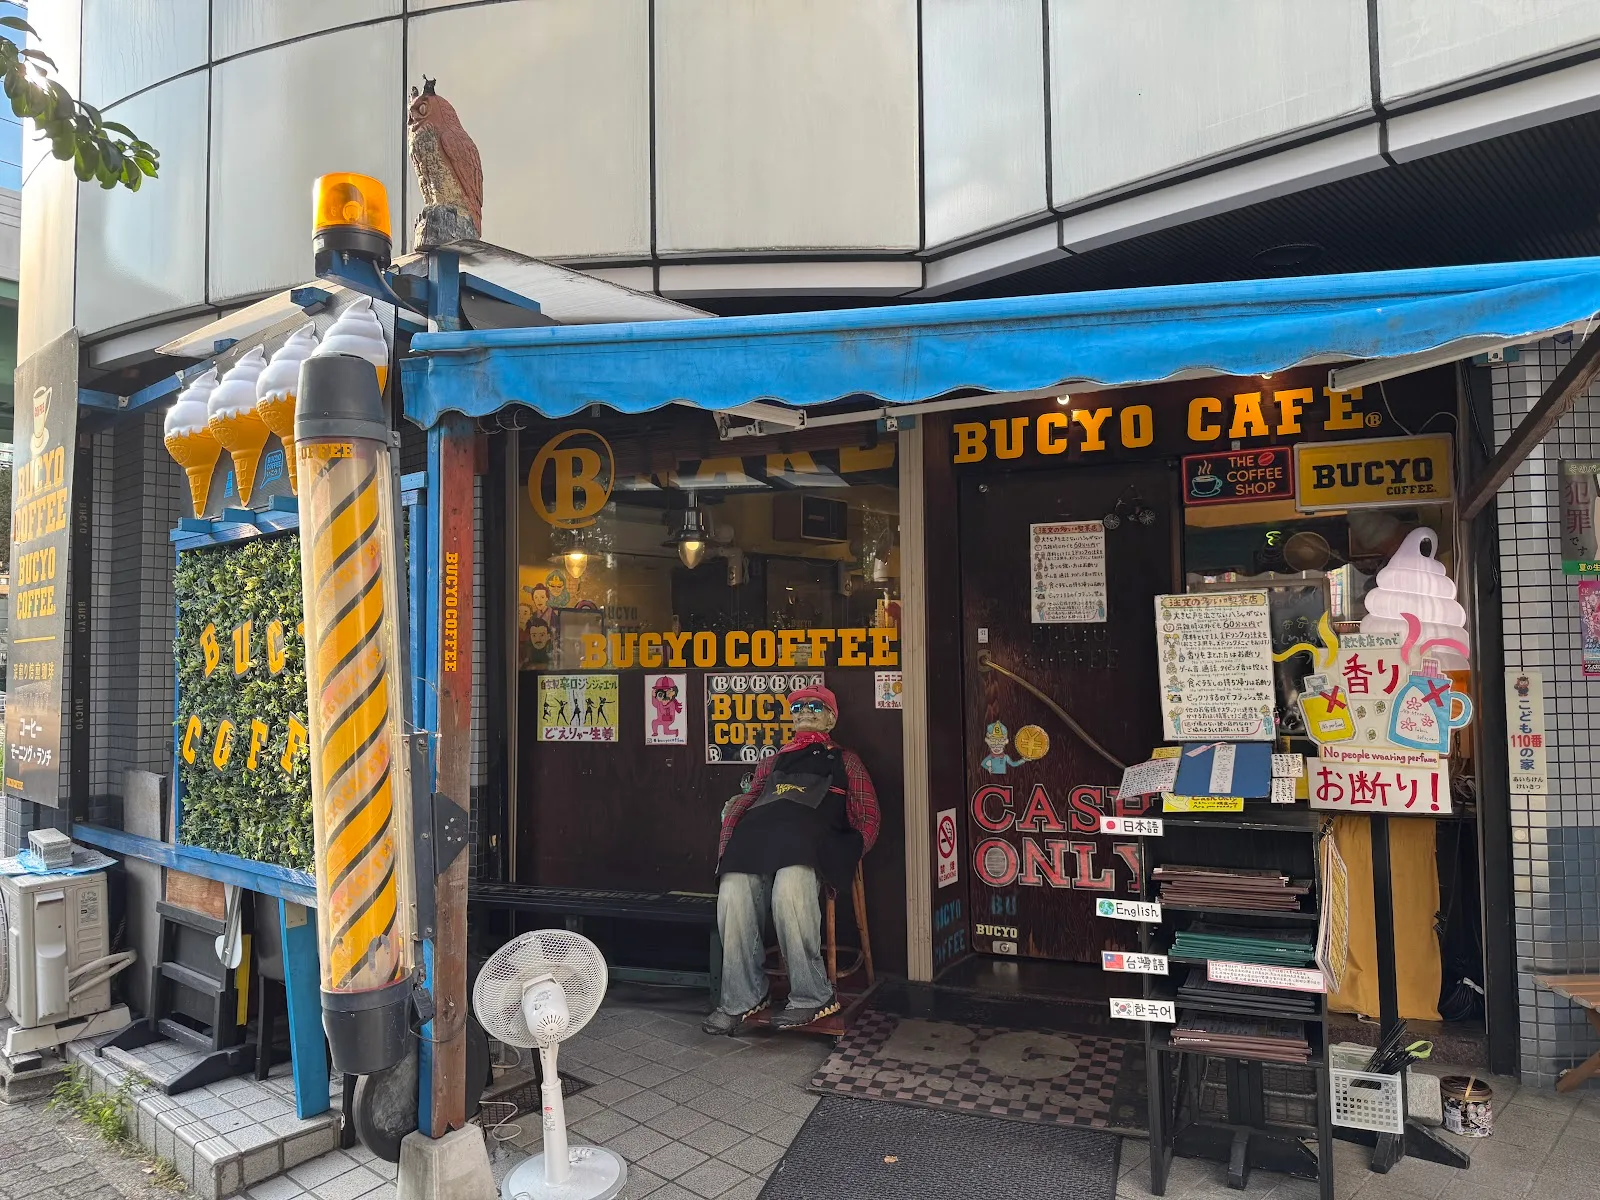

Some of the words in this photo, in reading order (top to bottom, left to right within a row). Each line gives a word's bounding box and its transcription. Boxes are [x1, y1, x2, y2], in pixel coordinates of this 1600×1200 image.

[953, 405, 1153, 463] BUCYO
[1228, 455, 1254, 468] THE
[1312, 457, 1433, 489] BUCYO
[17, 445, 65, 505] BUCYO
[1227, 467, 1283, 484] COFFEE
[1235, 481, 1276, 496] SHOP
[14, 487, 68, 544] COFFEE
[18, 546, 56, 587] BUCYO
[446, 552, 458, 607] BUCYO
[200, 619, 304, 678] BUC
[445, 609, 457, 671] COFFEE
[580, 631, 717, 668] BUCYO
[725, 628, 898, 667] COFFEE
[1342, 633, 1400, 649] 飲食店なので
[1342, 653, 1399, 695] 香り
[711, 693, 794, 720] BUCY
[20, 718, 42, 738] コーヒー
[544, 727, 615, 741] どえりゃー生姜
[714, 722, 796, 745] COFFE
[11, 743, 52, 766] モーニング・ランチ
[183, 714, 308, 774] COFF
[1323, 747, 1339, 758] No
[1341, 749, 1370, 762] people
[1372, 753, 1405, 763] wearing
[1407, 753, 1438, 764] perfume
[1316, 766, 1440, 811] お断り!
[1123, 820, 1159, 834] 日本語
[1116, 902, 1159, 917] English
[975, 923, 1018, 939] BUCYO
[1134, 1003, 1172, 1019] 한국어
